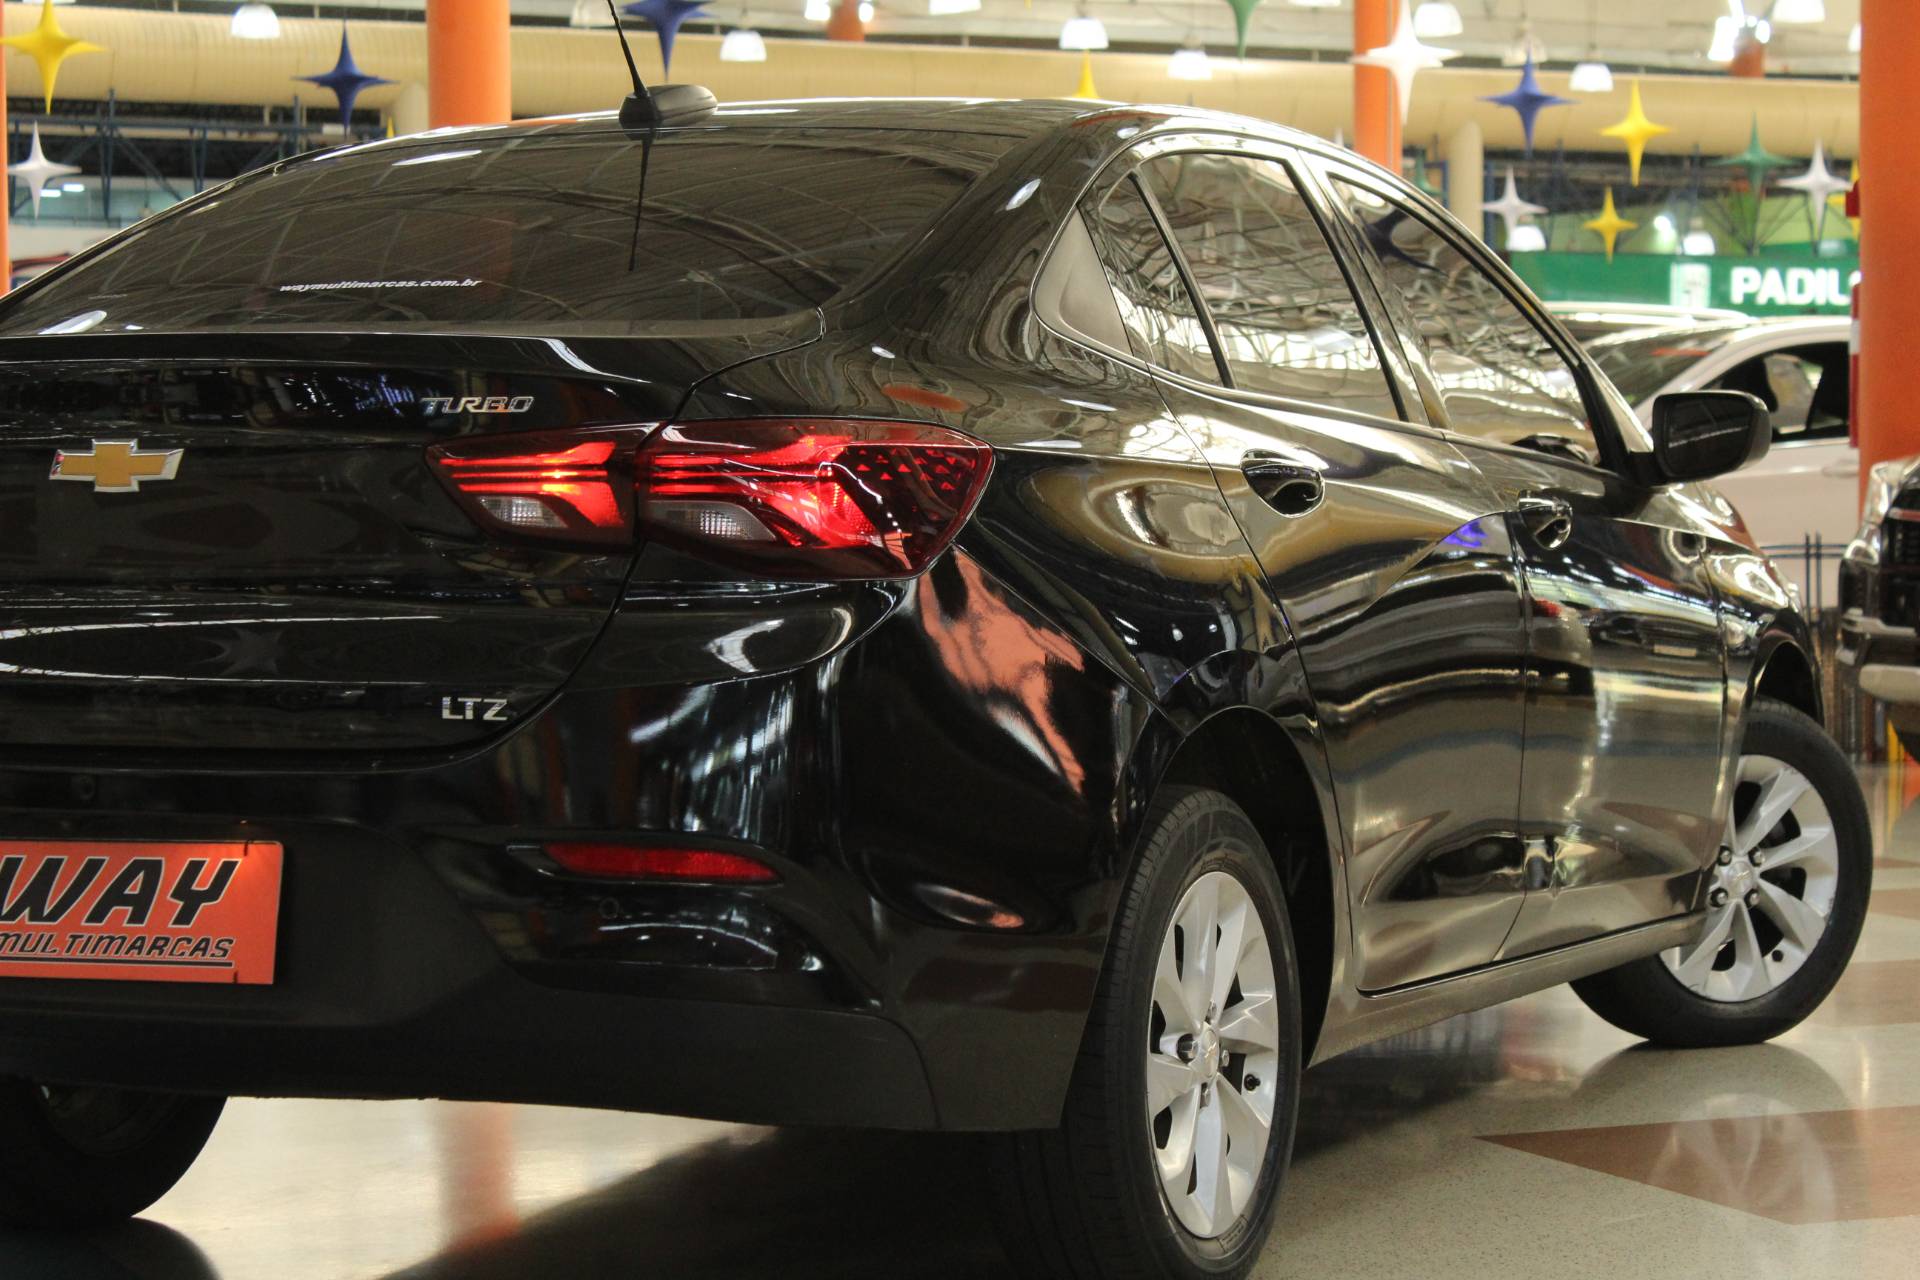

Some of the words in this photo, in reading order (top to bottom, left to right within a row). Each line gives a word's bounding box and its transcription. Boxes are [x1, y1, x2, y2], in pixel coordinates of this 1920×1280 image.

[279, 279, 483, 293] waymultimarcas.com.br
[1730, 266, 1861, 306] PADIL
[420, 396, 534, 416] TURBO
[442, 697, 507, 720] LTZ
[0, 855, 242, 928] WAY
[0, 932, 235, 959] MULTIMARCAS
